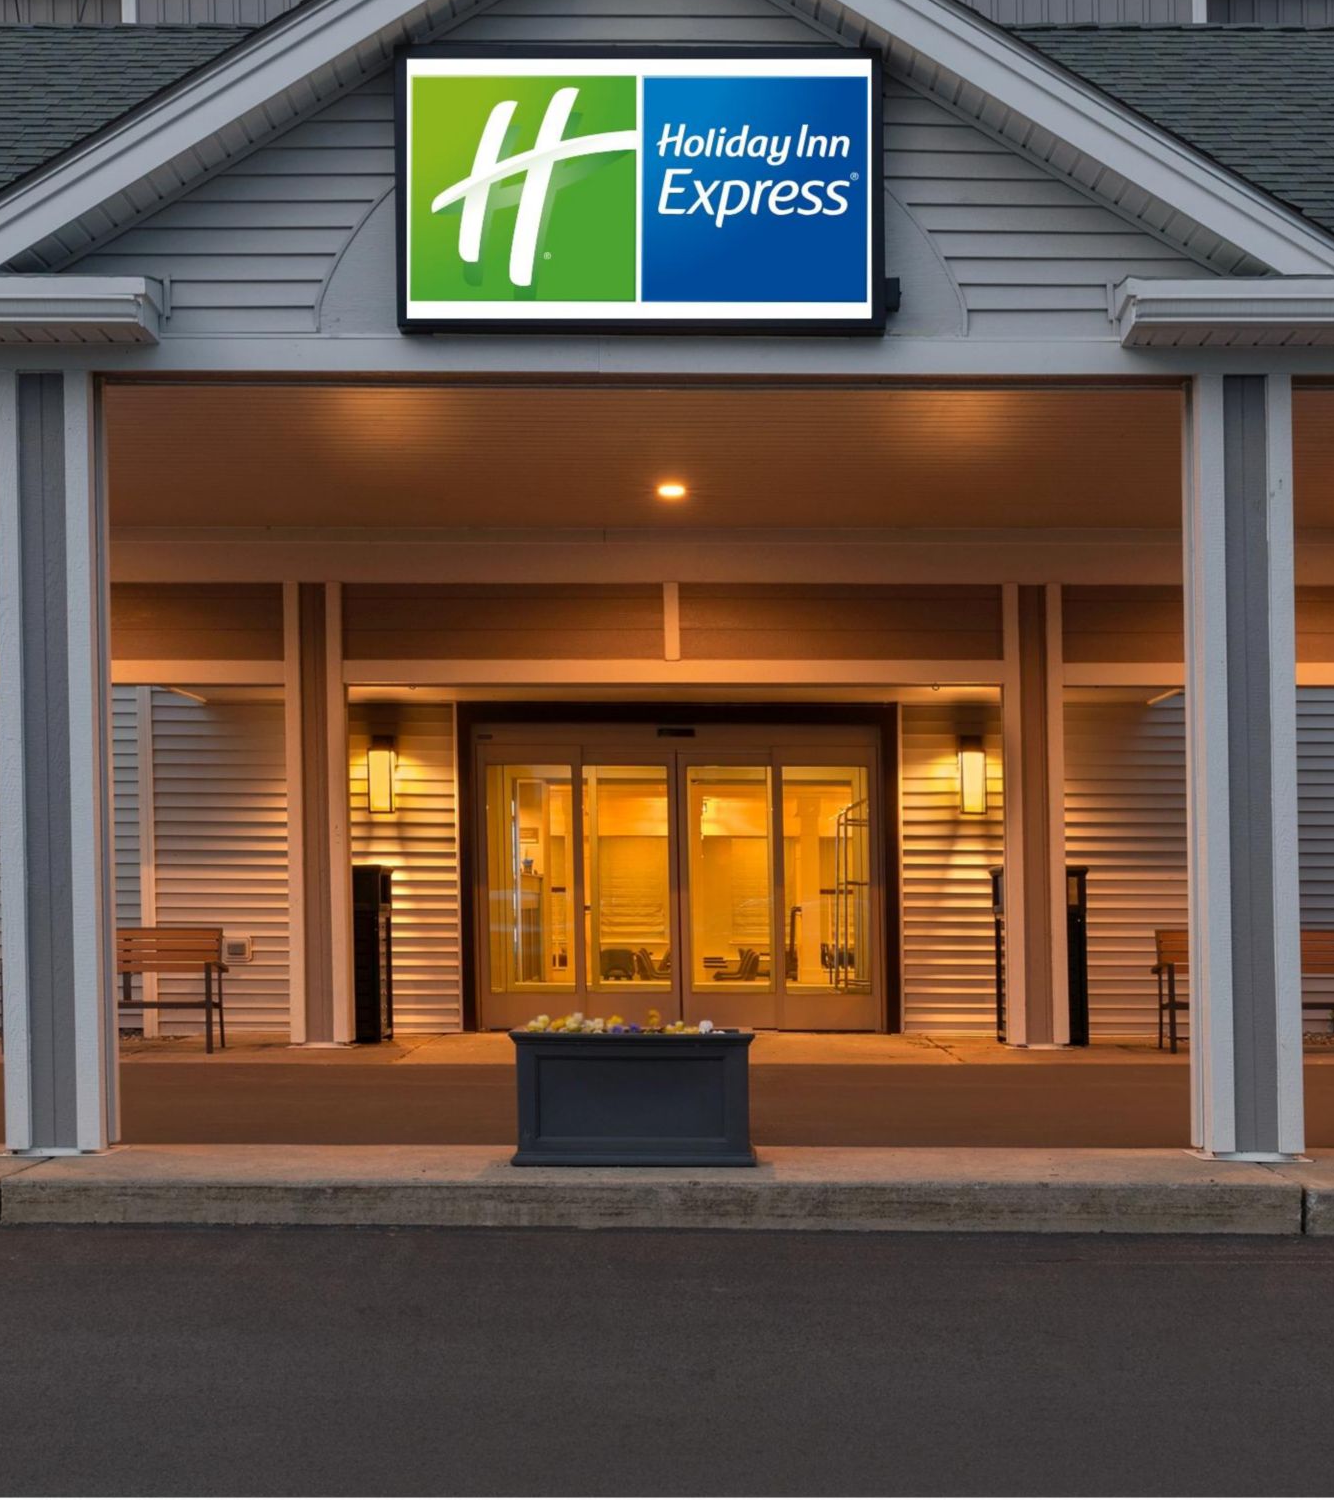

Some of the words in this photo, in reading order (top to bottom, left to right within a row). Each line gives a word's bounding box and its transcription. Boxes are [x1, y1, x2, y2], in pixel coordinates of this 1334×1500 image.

[431, 87, 636, 286] H
[657, 123, 786, 166] Holiday
[796, 123, 850, 158] Inn
